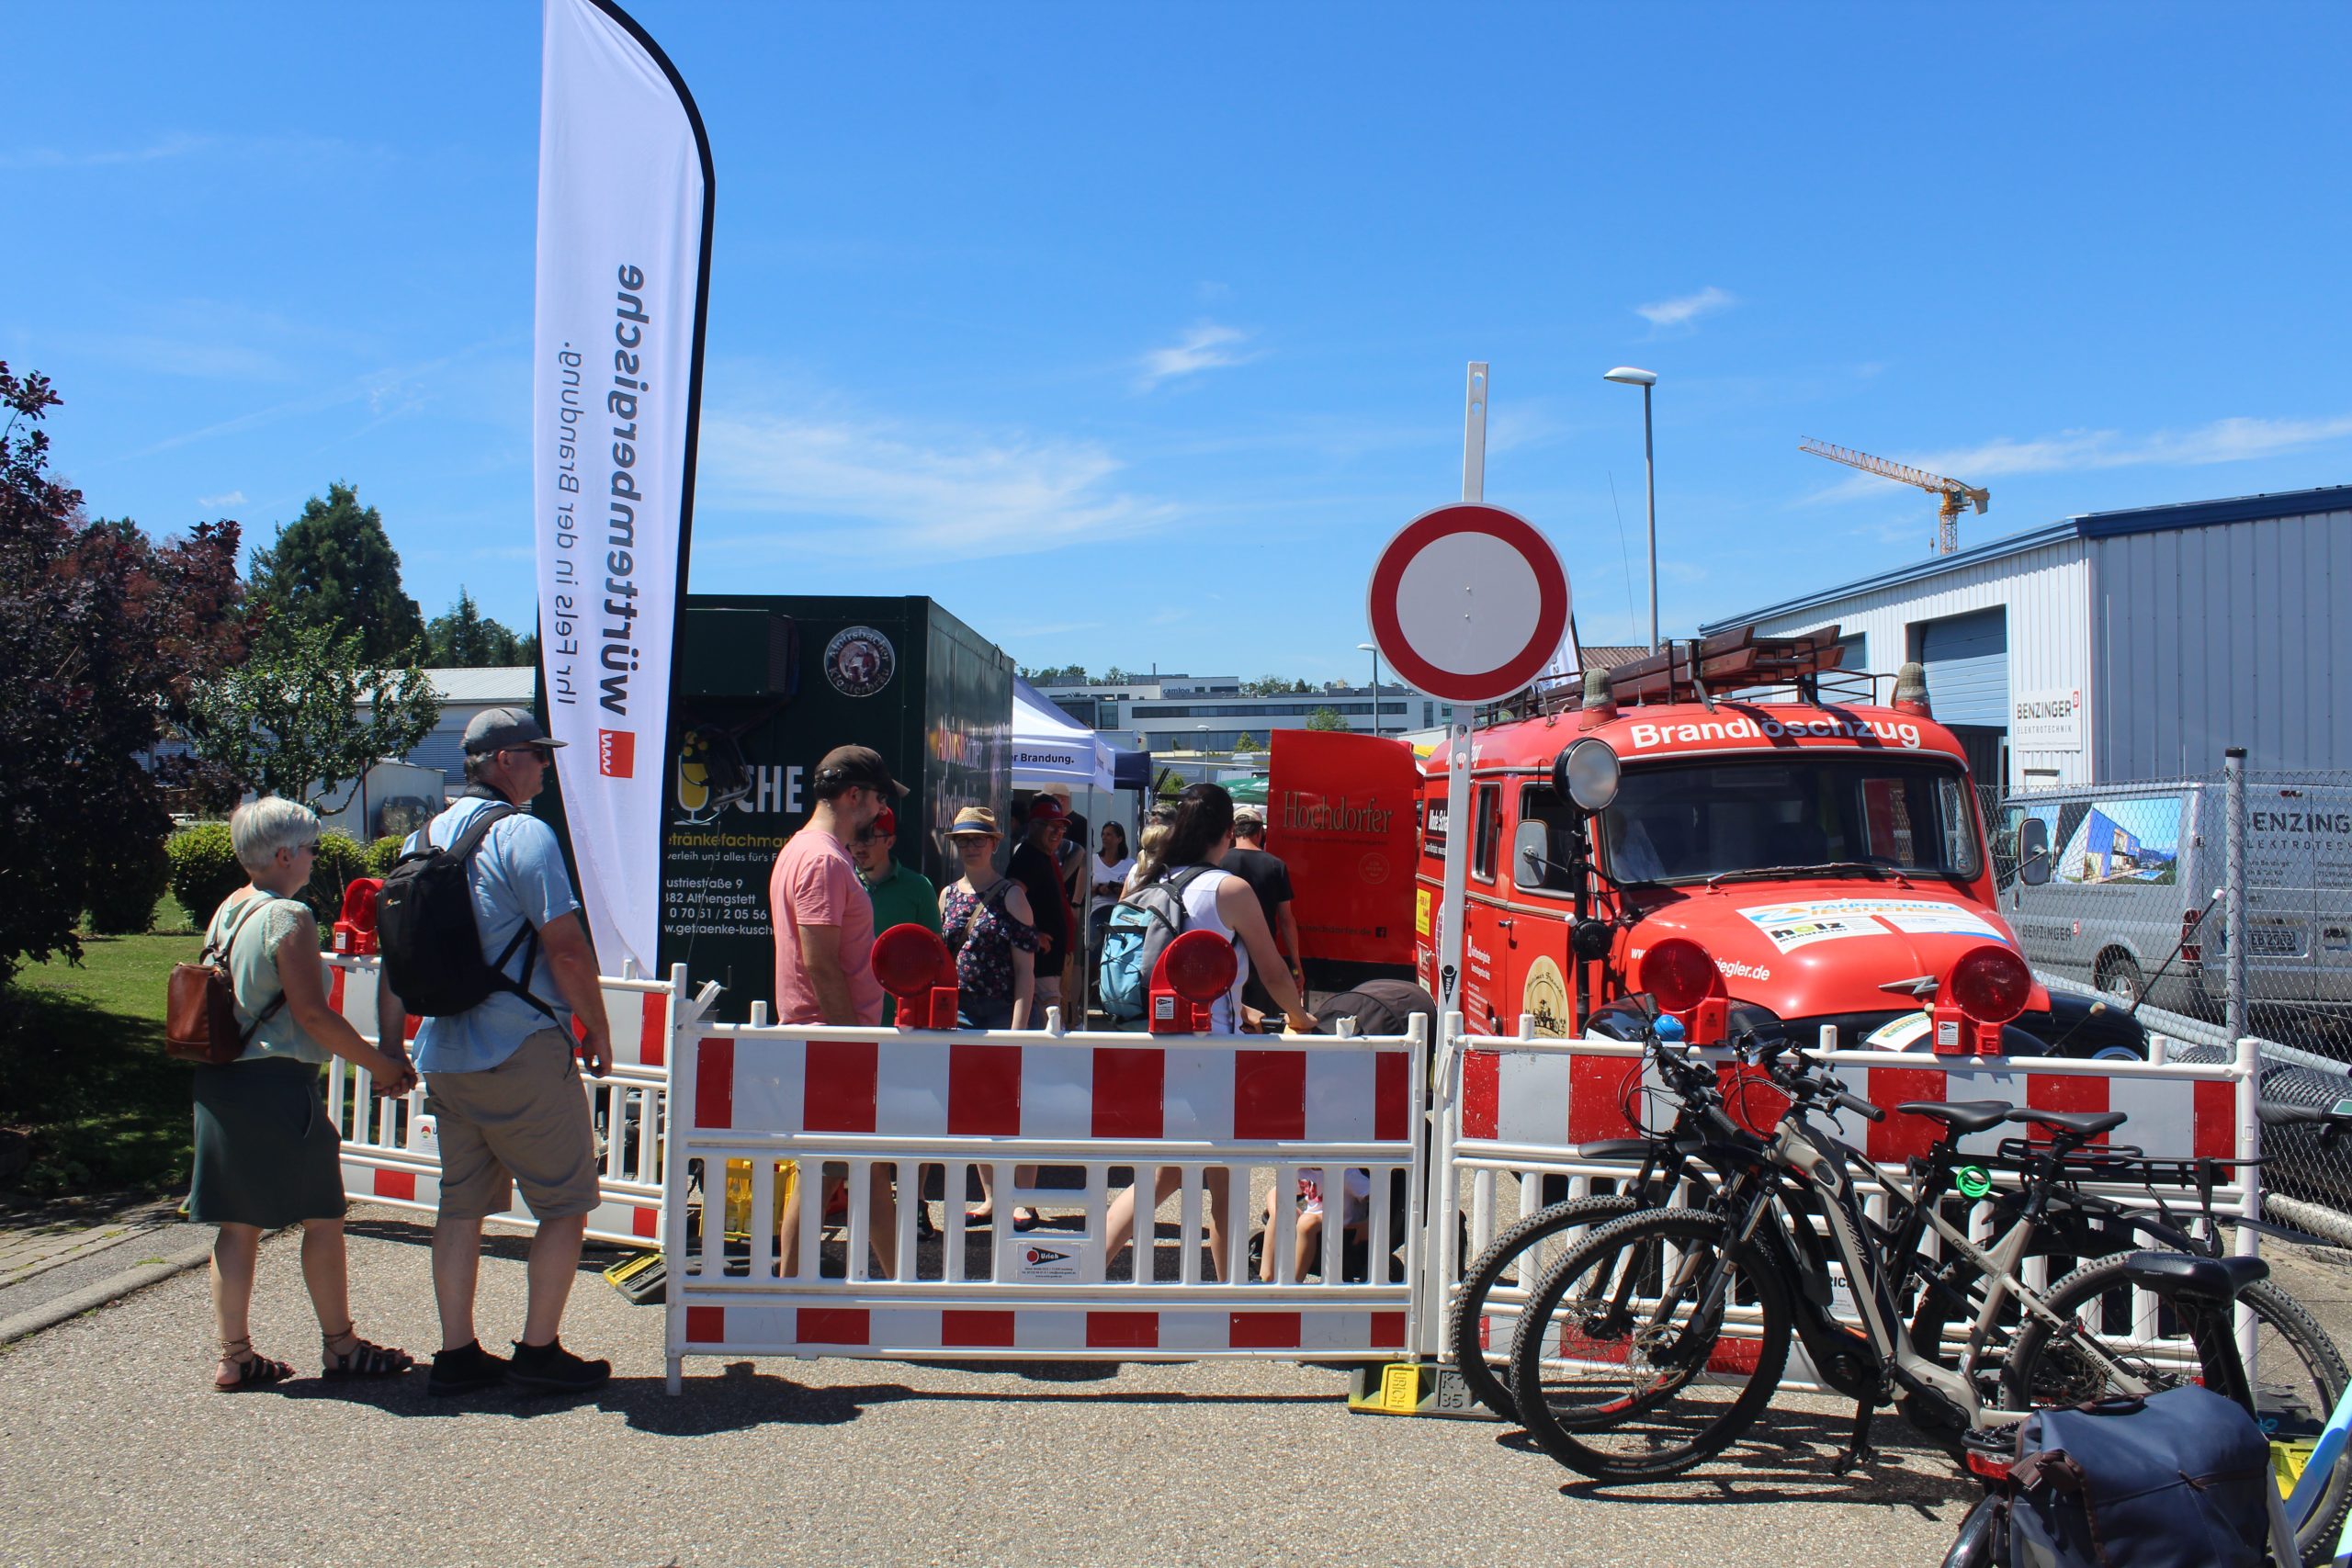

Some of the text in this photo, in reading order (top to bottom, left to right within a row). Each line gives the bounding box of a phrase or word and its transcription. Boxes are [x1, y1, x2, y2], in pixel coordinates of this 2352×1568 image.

[2018, 700, 2072, 719] BENZINGER
[1630, 716, 1921, 750] Brandlöschzug
[2017, 725, 2073, 734] ELEKTROTECHNIK
[1021, 753, 1075, 764] Brandung.
[1283, 791, 1393, 833] Hochdorfer
[723, 852, 746, 862] alles
[749, 852, 768, 863] für's
[736, 878, 743, 889] 9
[686, 893, 756, 907] Althengstett
[723, 908, 730, 919] 2
[734, 909, 749, 919] 05
[752, 909, 767, 920] 56
[1770, 921, 1846, 938] holz
[2085, 1350, 2115, 1376] CAIRON
[1390, 1371, 1408, 1408] URICH
